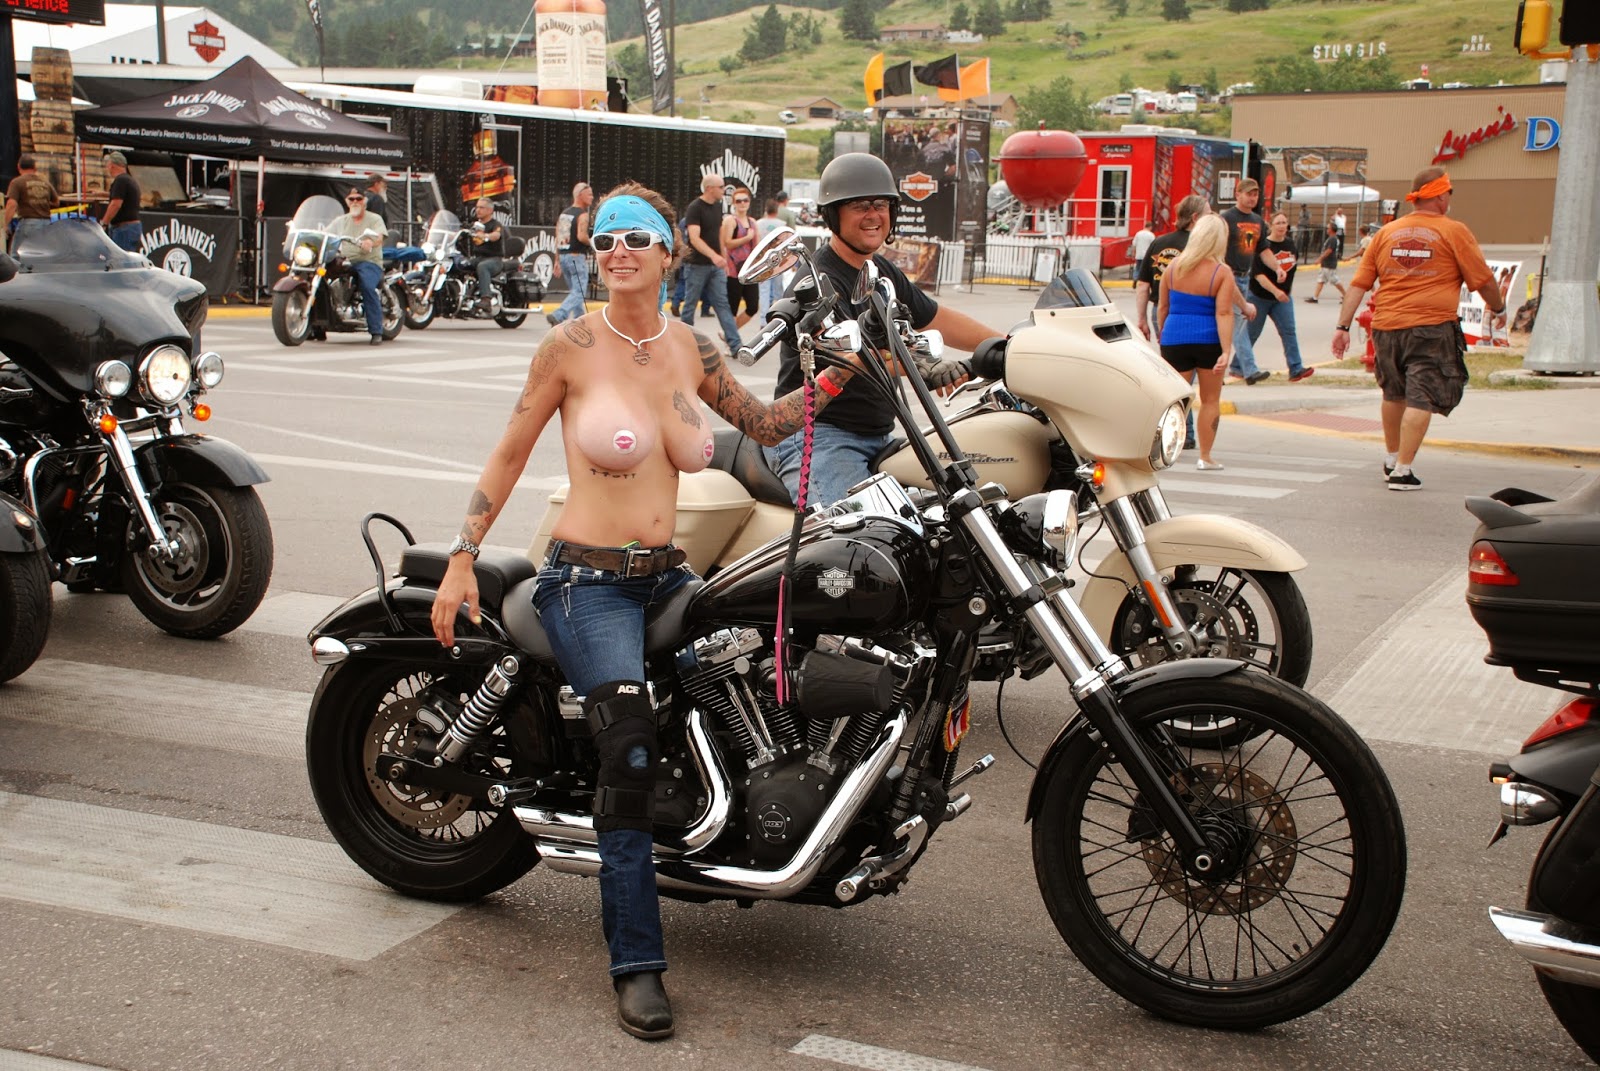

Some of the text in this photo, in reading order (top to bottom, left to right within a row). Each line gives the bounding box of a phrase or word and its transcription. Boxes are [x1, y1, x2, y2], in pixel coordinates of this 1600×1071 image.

[647, 7, 668, 79] DANIEL'S
[1470, 34, 1485, 43] RV
[1312, 41, 1388, 60] STURGIS
[1462, 43, 1492, 52] PARK
[164, 93, 203, 108] JACK
[201, 89, 247, 114] DANIEL'S
[85, 124, 98, 133] Your
[98, 126, 119, 135] Friends
[120, 127, 127, 135] at
[127, 127, 140, 136] Jack
[141, 128, 163, 137] Daniel's
[163, 129, 184, 139] Remind
[185, 131, 196, 140] You
[202, 132, 217, 142] Drink
[1432, 105, 1561, 165] Lynn's D
[270, 139, 281, 148] Your
[281, 139, 299, 150] Friends
[304, 142, 316, 151] Jack
[334, 144, 351, 154] Remind
[724, 148, 761, 198] DANIEL'S
[900, 204, 915, 213] You
[916, 214, 926, 223] of
[899, 224, 927, 233] Official
[140, 218, 217, 263] JACK DANIEL'S
[938, 451, 980, 460] Haey
[617, 684, 640, 695] ACE
